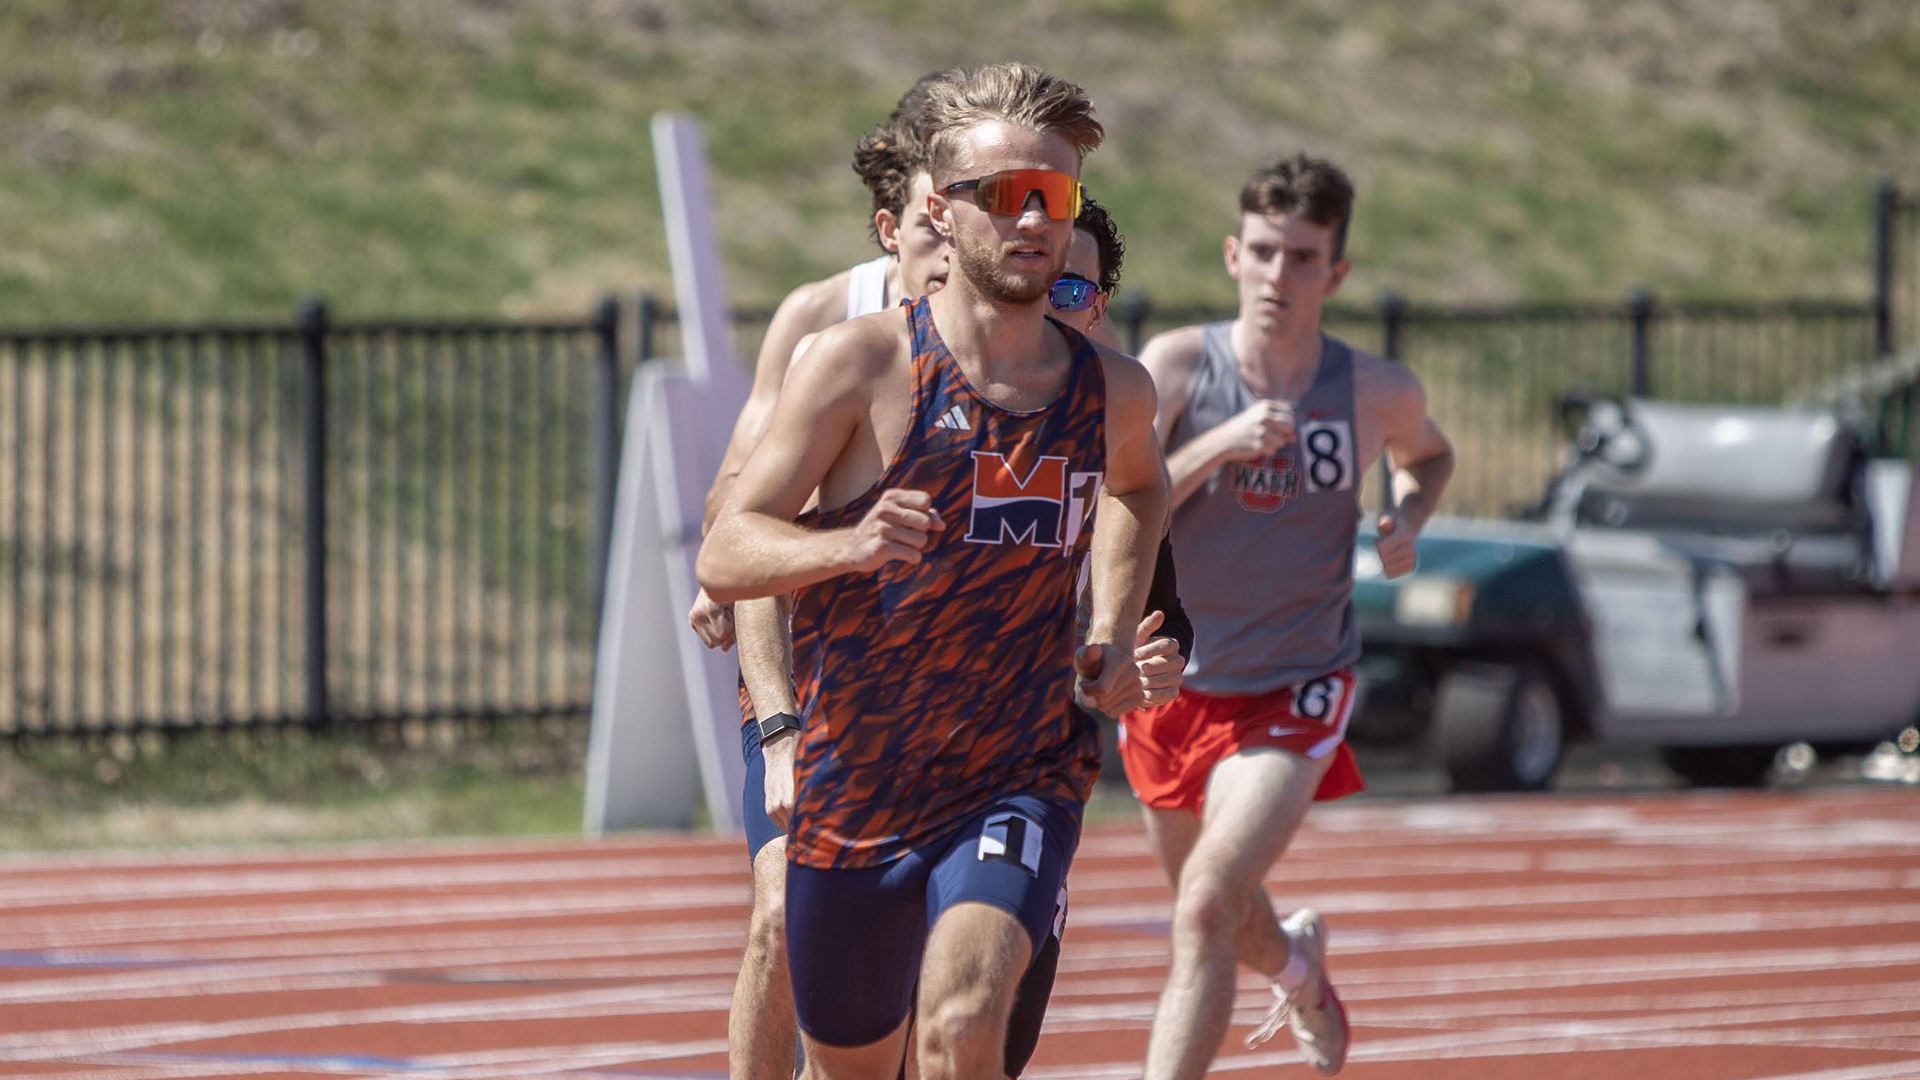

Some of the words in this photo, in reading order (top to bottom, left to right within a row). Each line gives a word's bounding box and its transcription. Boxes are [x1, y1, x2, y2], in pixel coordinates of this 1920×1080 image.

[1307, 429, 1342, 488] 8
[963, 451, 1069, 548] M
[1299, 679, 1333, 719] 6
[978, 814, 1040, 877] 1
